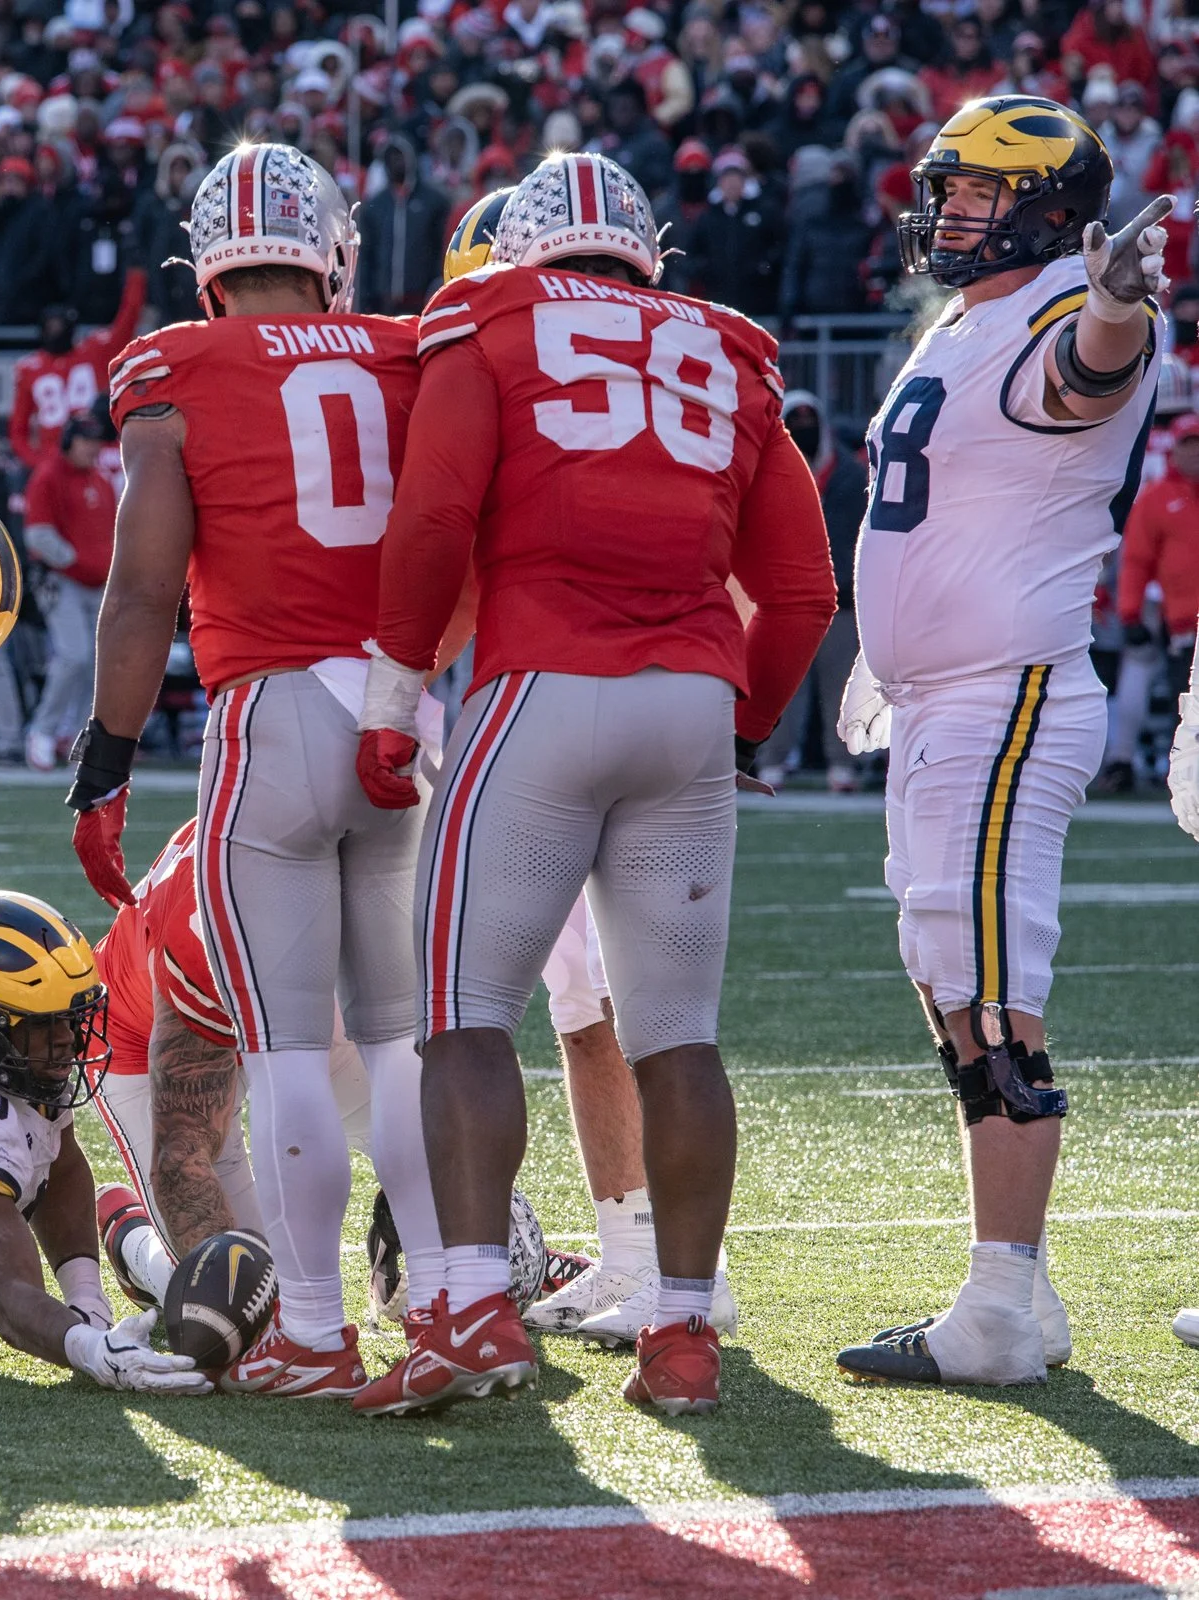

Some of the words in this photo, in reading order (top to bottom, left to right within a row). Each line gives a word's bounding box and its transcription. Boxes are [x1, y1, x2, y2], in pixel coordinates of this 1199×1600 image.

[204, 244, 301, 266] BUCKEYES
[540, 231, 640, 252] BUCKEYES
[257, 324, 376, 358] SIMON
[532, 299, 739, 474] 58
[280, 358, 395, 549] 0
[868, 375, 948, 534] 8
